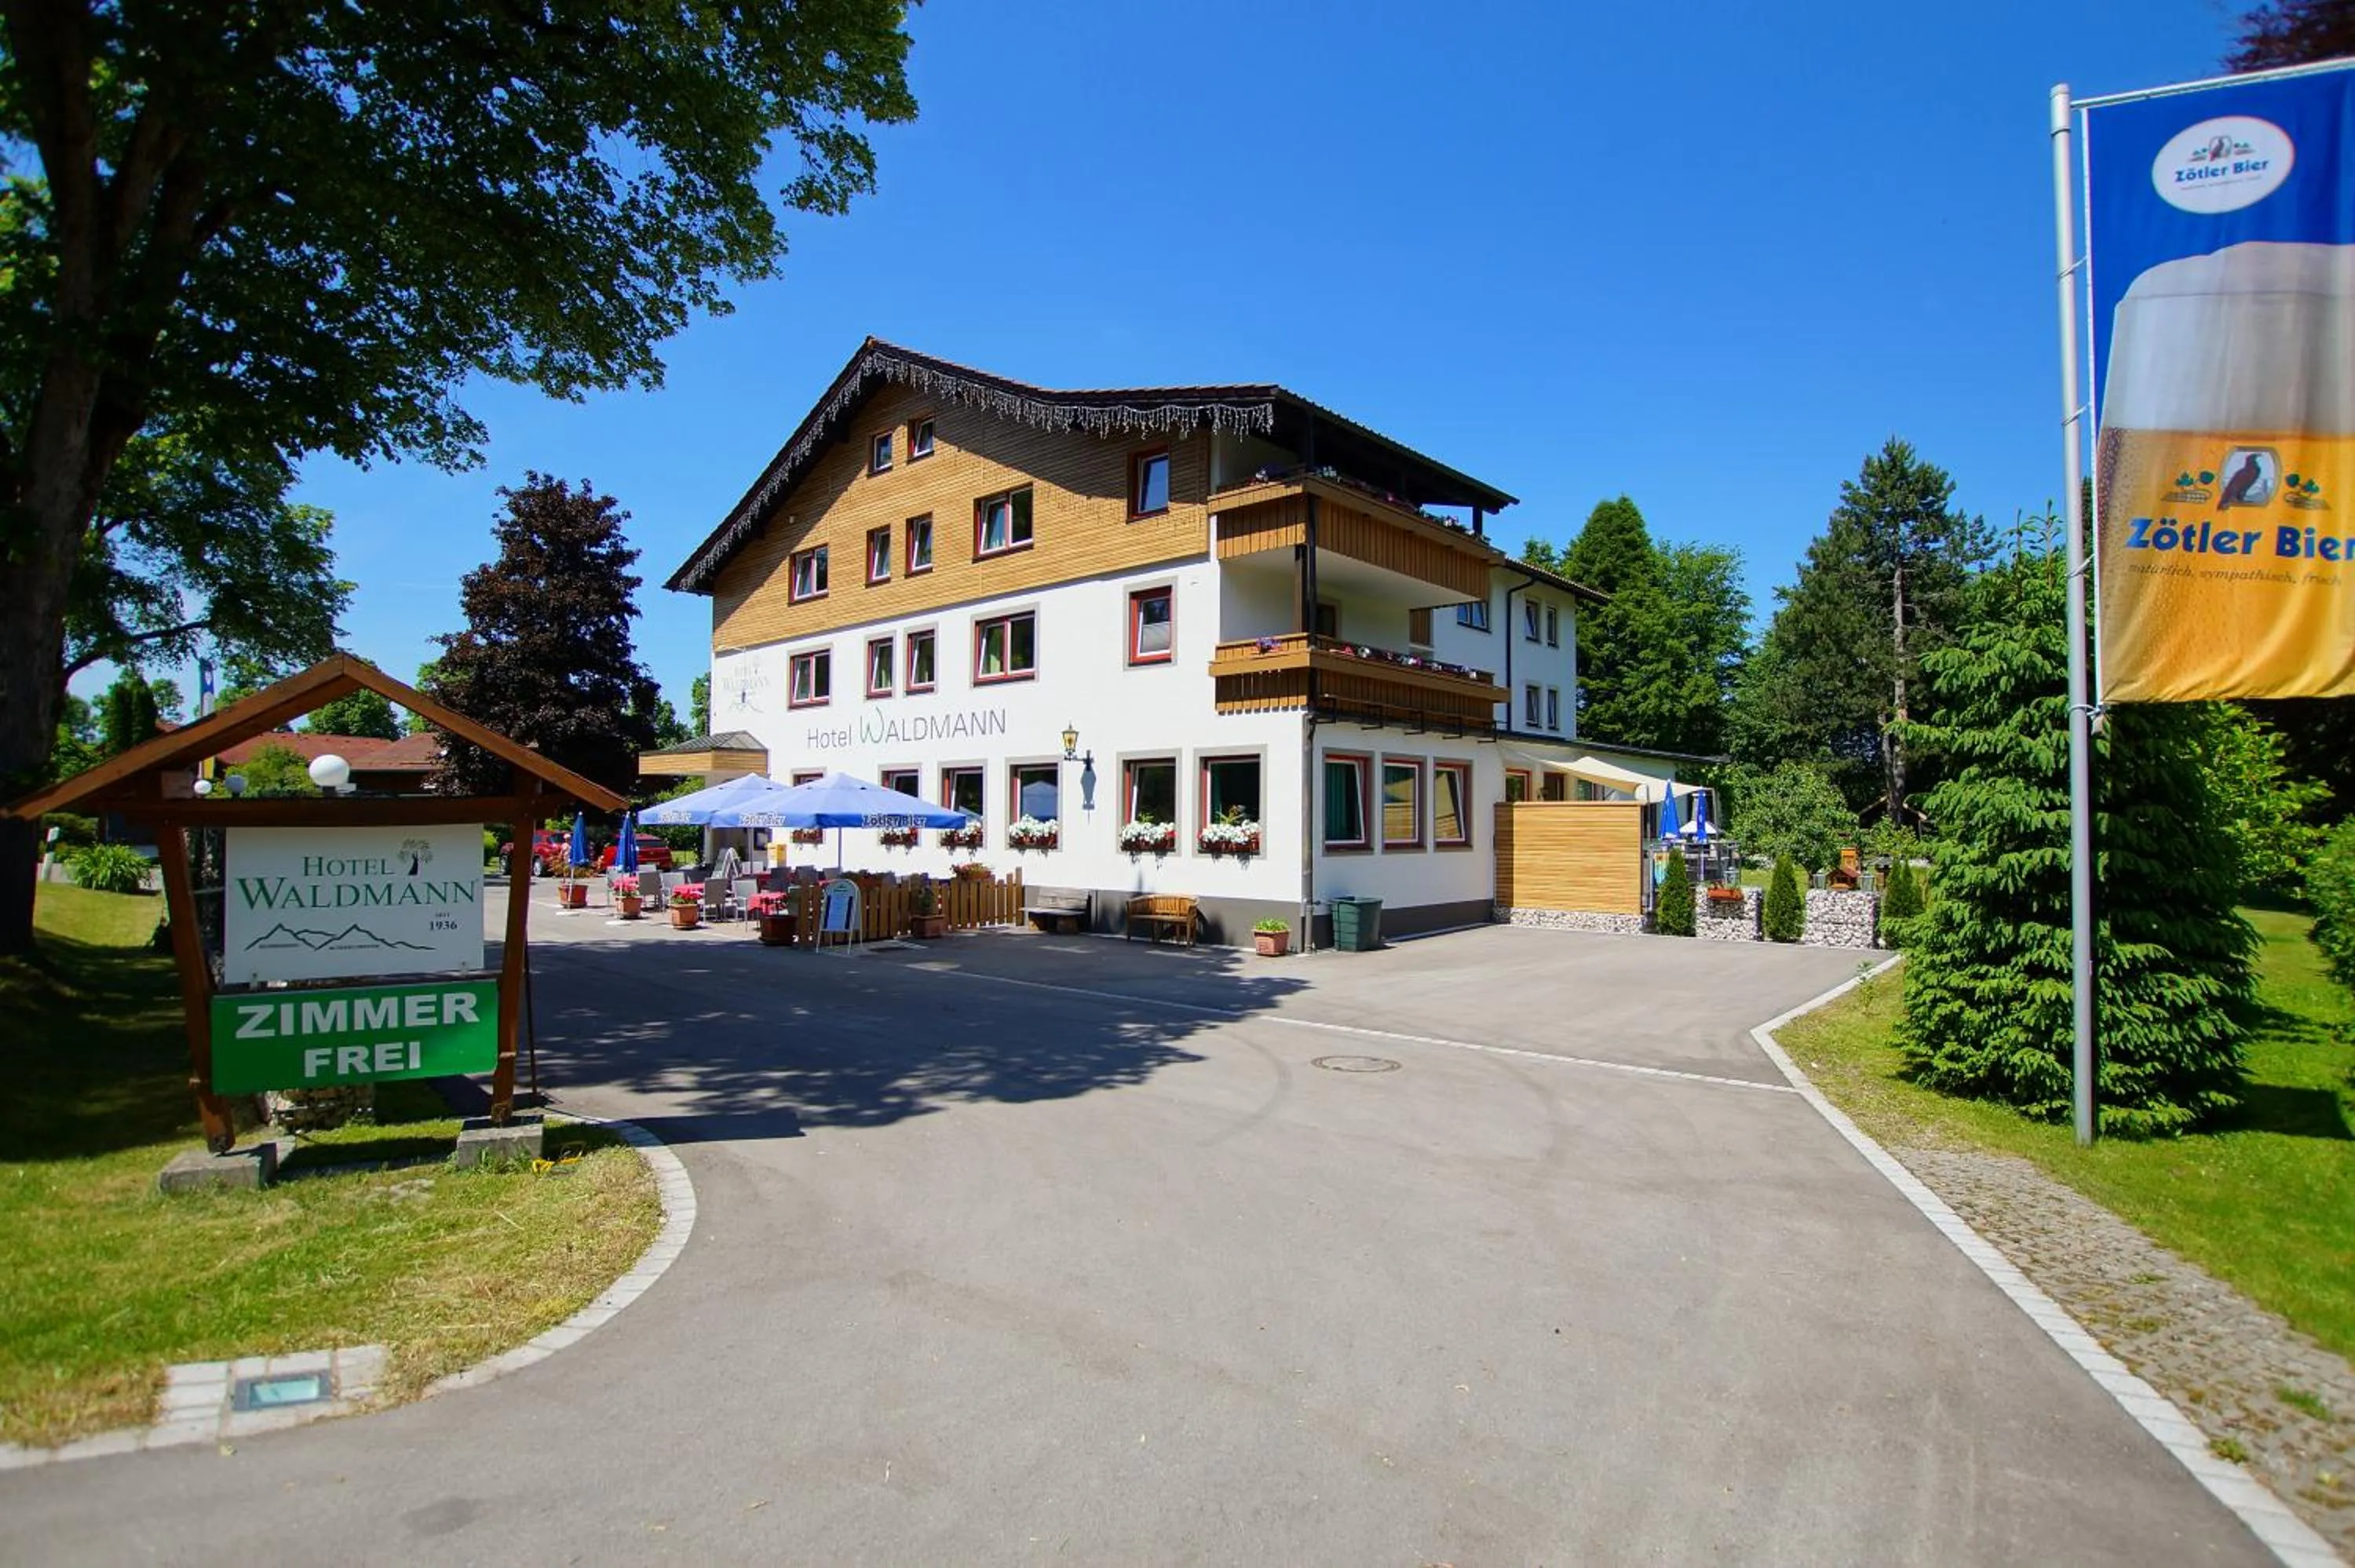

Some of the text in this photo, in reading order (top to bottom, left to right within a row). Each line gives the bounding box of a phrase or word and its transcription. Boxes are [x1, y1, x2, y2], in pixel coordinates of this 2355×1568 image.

[2174, 166, 2228, 183] Zötler
[2232, 159, 2269, 174] Bier
[2126, 517, 2263, 555] Zötler
[807, 706, 1006, 749] Hotel WALDMANN
[303, 856, 395, 877] HOTEL
[237, 877, 475, 910] WALDMANN
[429, 921, 458, 931] 1936
[236, 991, 480, 1039] ZIMMER
[304, 1041, 422, 1078] FREI
